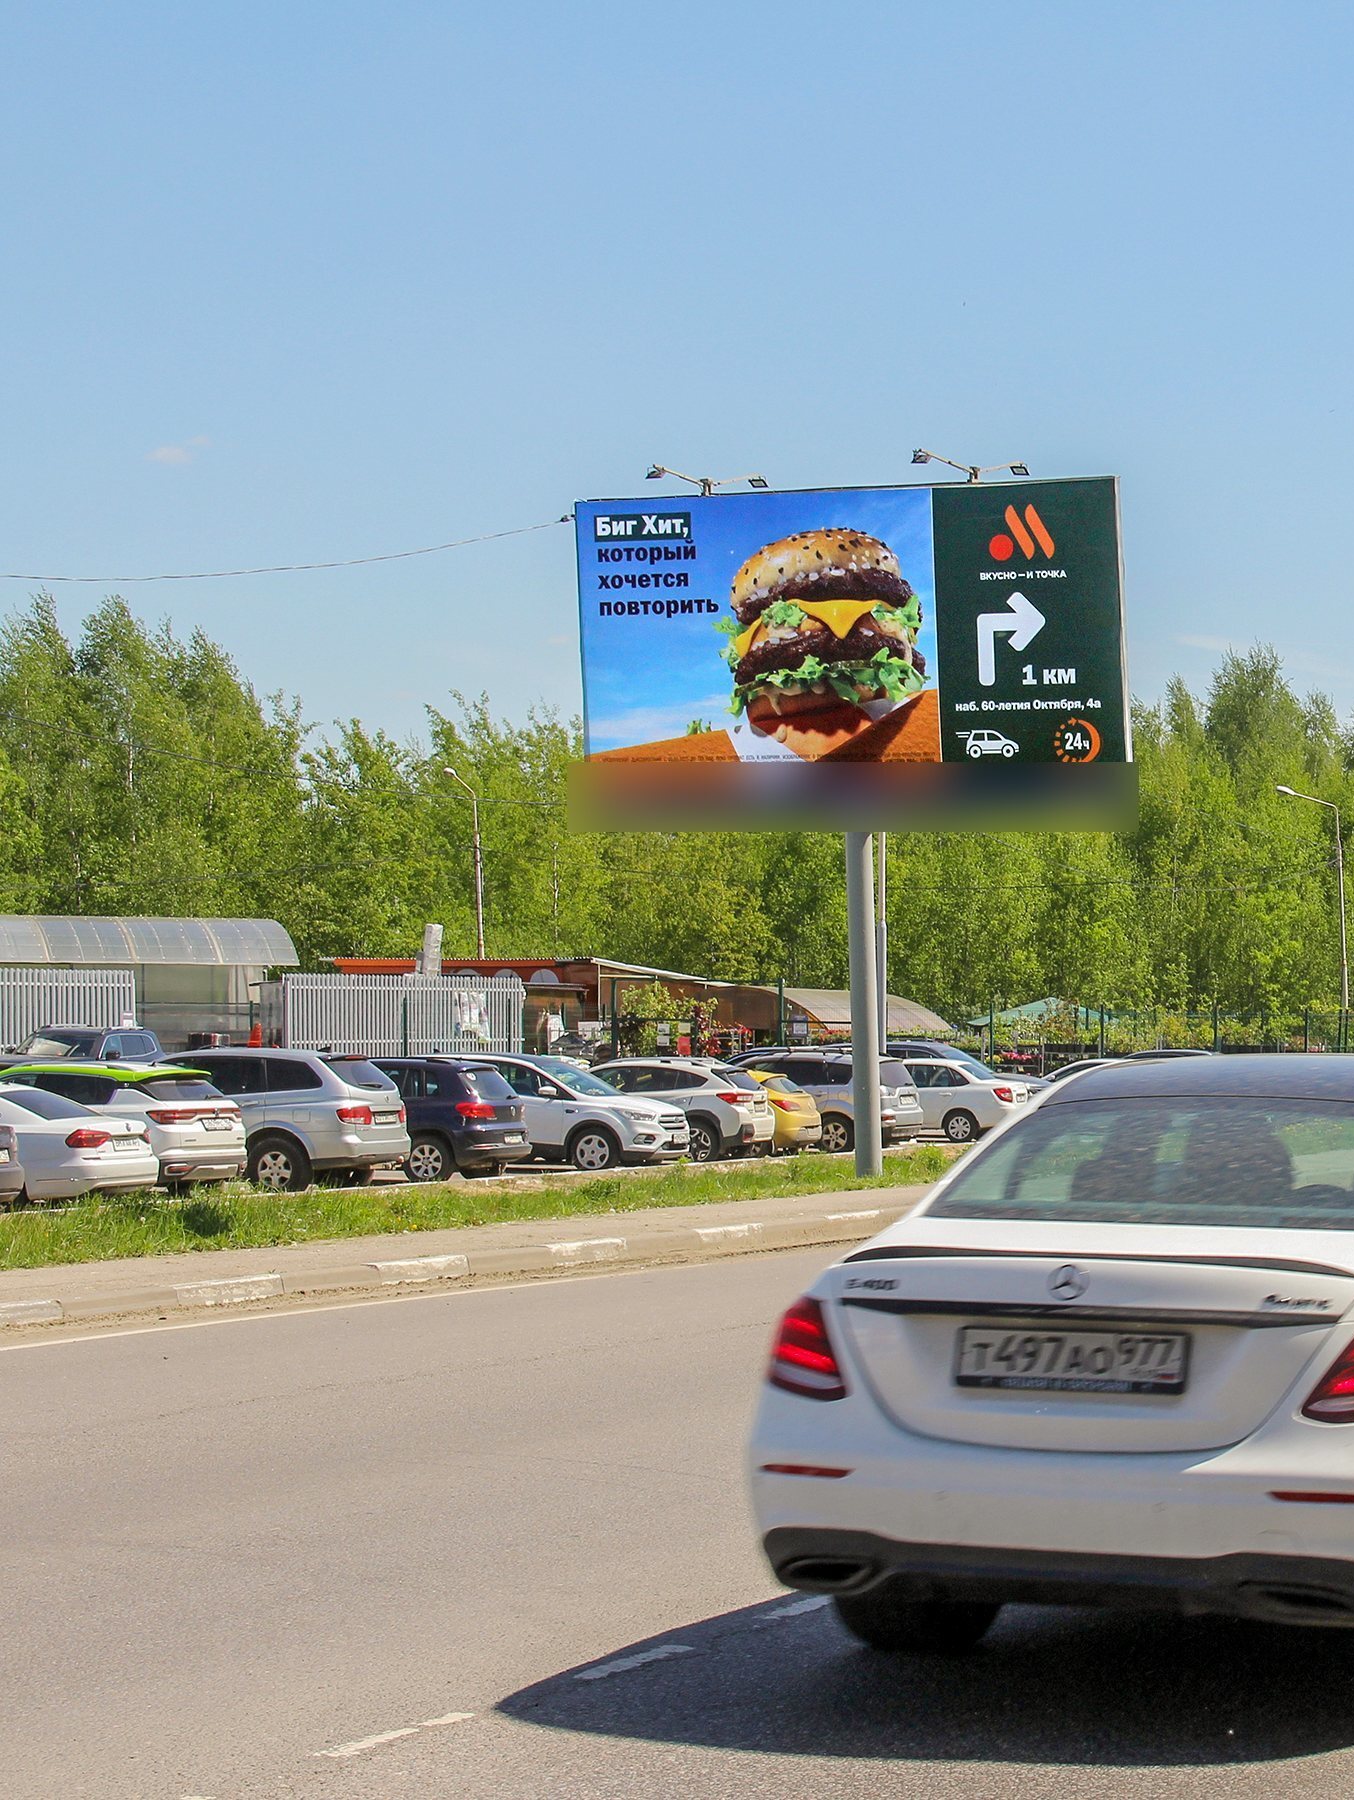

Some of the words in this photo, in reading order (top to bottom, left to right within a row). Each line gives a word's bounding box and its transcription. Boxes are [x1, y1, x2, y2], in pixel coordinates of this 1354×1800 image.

[596, 516, 638, 537] Биг
[641, 514, 689, 538] Хит,
[597, 539, 697, 565] который
[597, 572, 689, 589] хочется
[980, 571, 1017, 581] ВКУСНО
[1035, 569, 1067, 579] ТОЧКА
[599, 598, 720, 618] повторить
[1022, 664, 1037, 685] 1
[955, 701, 979, 711] наб.
[981, 700, 1031, 711] 60-летия
[1032, 698, 1085, 711] Октября,
[1086, 698, 1101, 709] 4а
